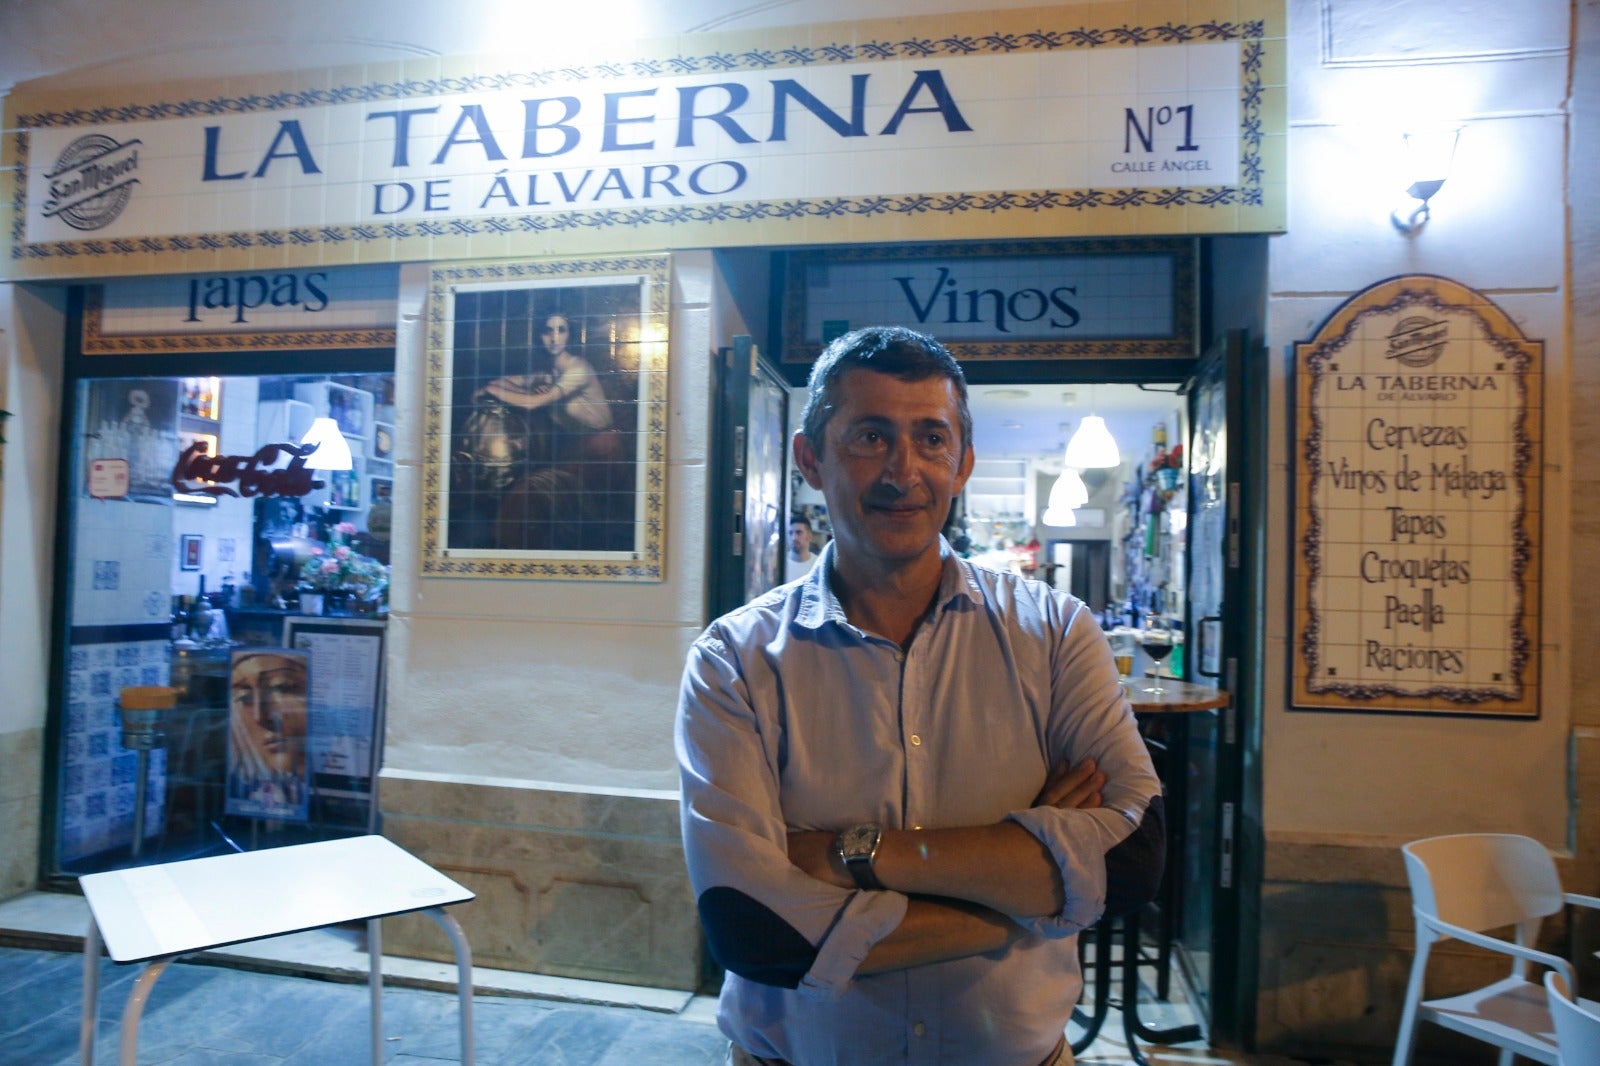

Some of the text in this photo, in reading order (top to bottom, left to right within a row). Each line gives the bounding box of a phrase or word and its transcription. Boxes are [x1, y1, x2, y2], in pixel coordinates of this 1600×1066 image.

[202, 119, 322, 181] LA
[366, 69, 974, 168] TABERNA
[1111, 162, 1155, 173] CALLE
[373, 161, 747, 214] DE ÁLVARO
[893, 267, 1081, 332] Vinos
[1336, 376, 1497, 390] LA TABERNA
[1367, 418, 1468, 450] Cervezas
[1328, 454, 1507, 499] Vinos de Málaga
[1386, 507, 1447, 543] Tapas
[1360, 549, 1471, 587] Croquetas
[1384, 588, 1445, 632] Paella
[1365, 640, 1464, 675] Raciones
